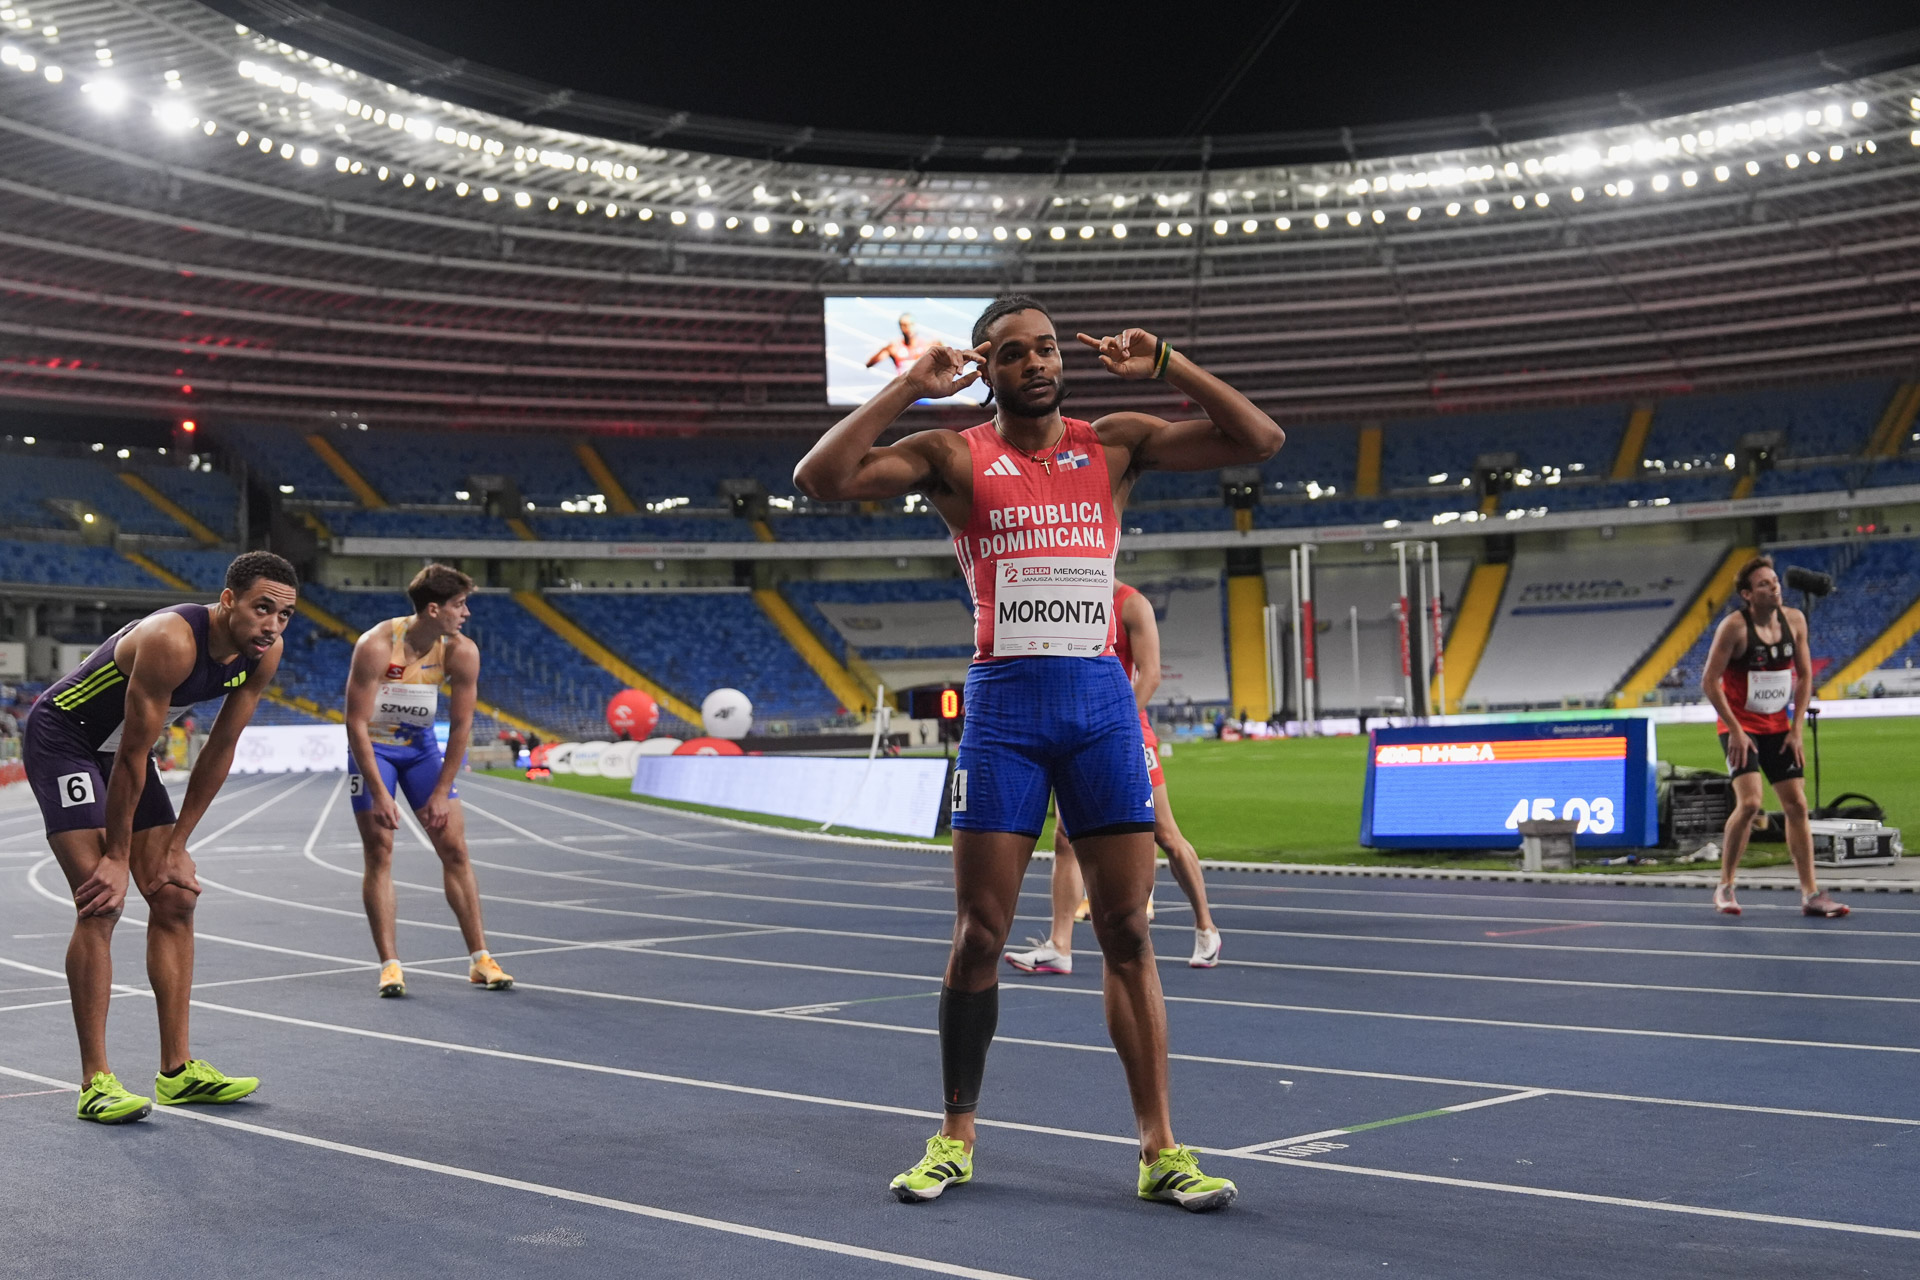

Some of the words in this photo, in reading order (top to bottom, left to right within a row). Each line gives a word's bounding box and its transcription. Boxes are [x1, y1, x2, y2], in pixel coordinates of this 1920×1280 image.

[989, 501, 1103, 531] REPUBLICA
[979, 526, 1106, 559] DOMINICANA
[1023, 567, 1050, 575] ORLEN
[999, 600, 1107, 625] MORONTA
[380, 703, 429, 717] SZWED
[941, 688, 958, 718] 0
[1479, 743, 1495, 761] A
[67, 776, 87, 803] 6
[350, 775, 359, 794] 5
[953, 773, 962, 809] 4
